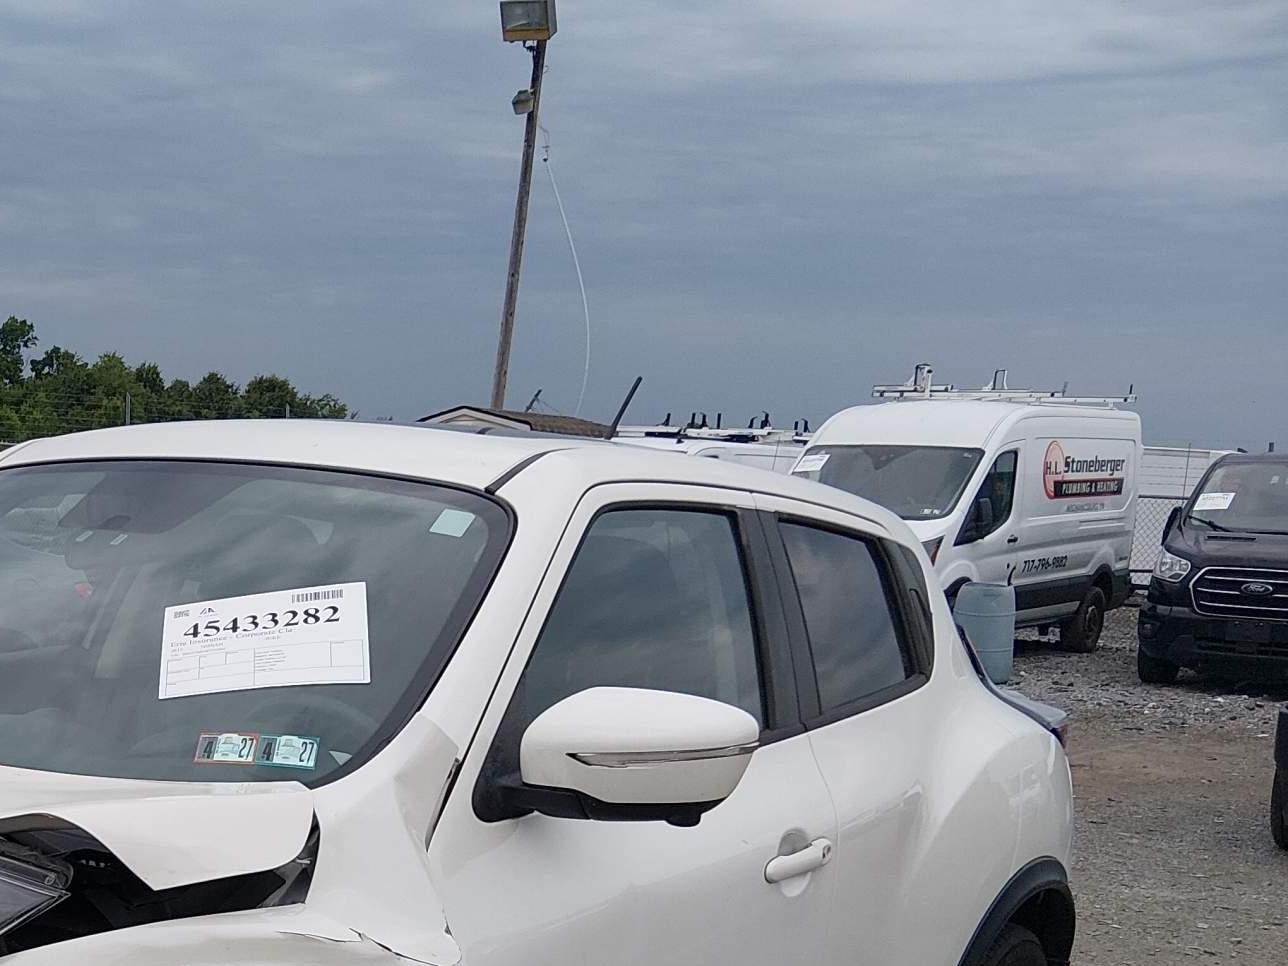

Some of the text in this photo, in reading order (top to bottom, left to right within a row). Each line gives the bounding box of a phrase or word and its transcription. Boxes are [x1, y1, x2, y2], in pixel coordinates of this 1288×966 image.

[1063, 455, 1125, 476] Stoneberger
[183, 605, 341, 638] 45433282
[238, 738, 254, 760] 27
[299, 741, 315, 764] 27
